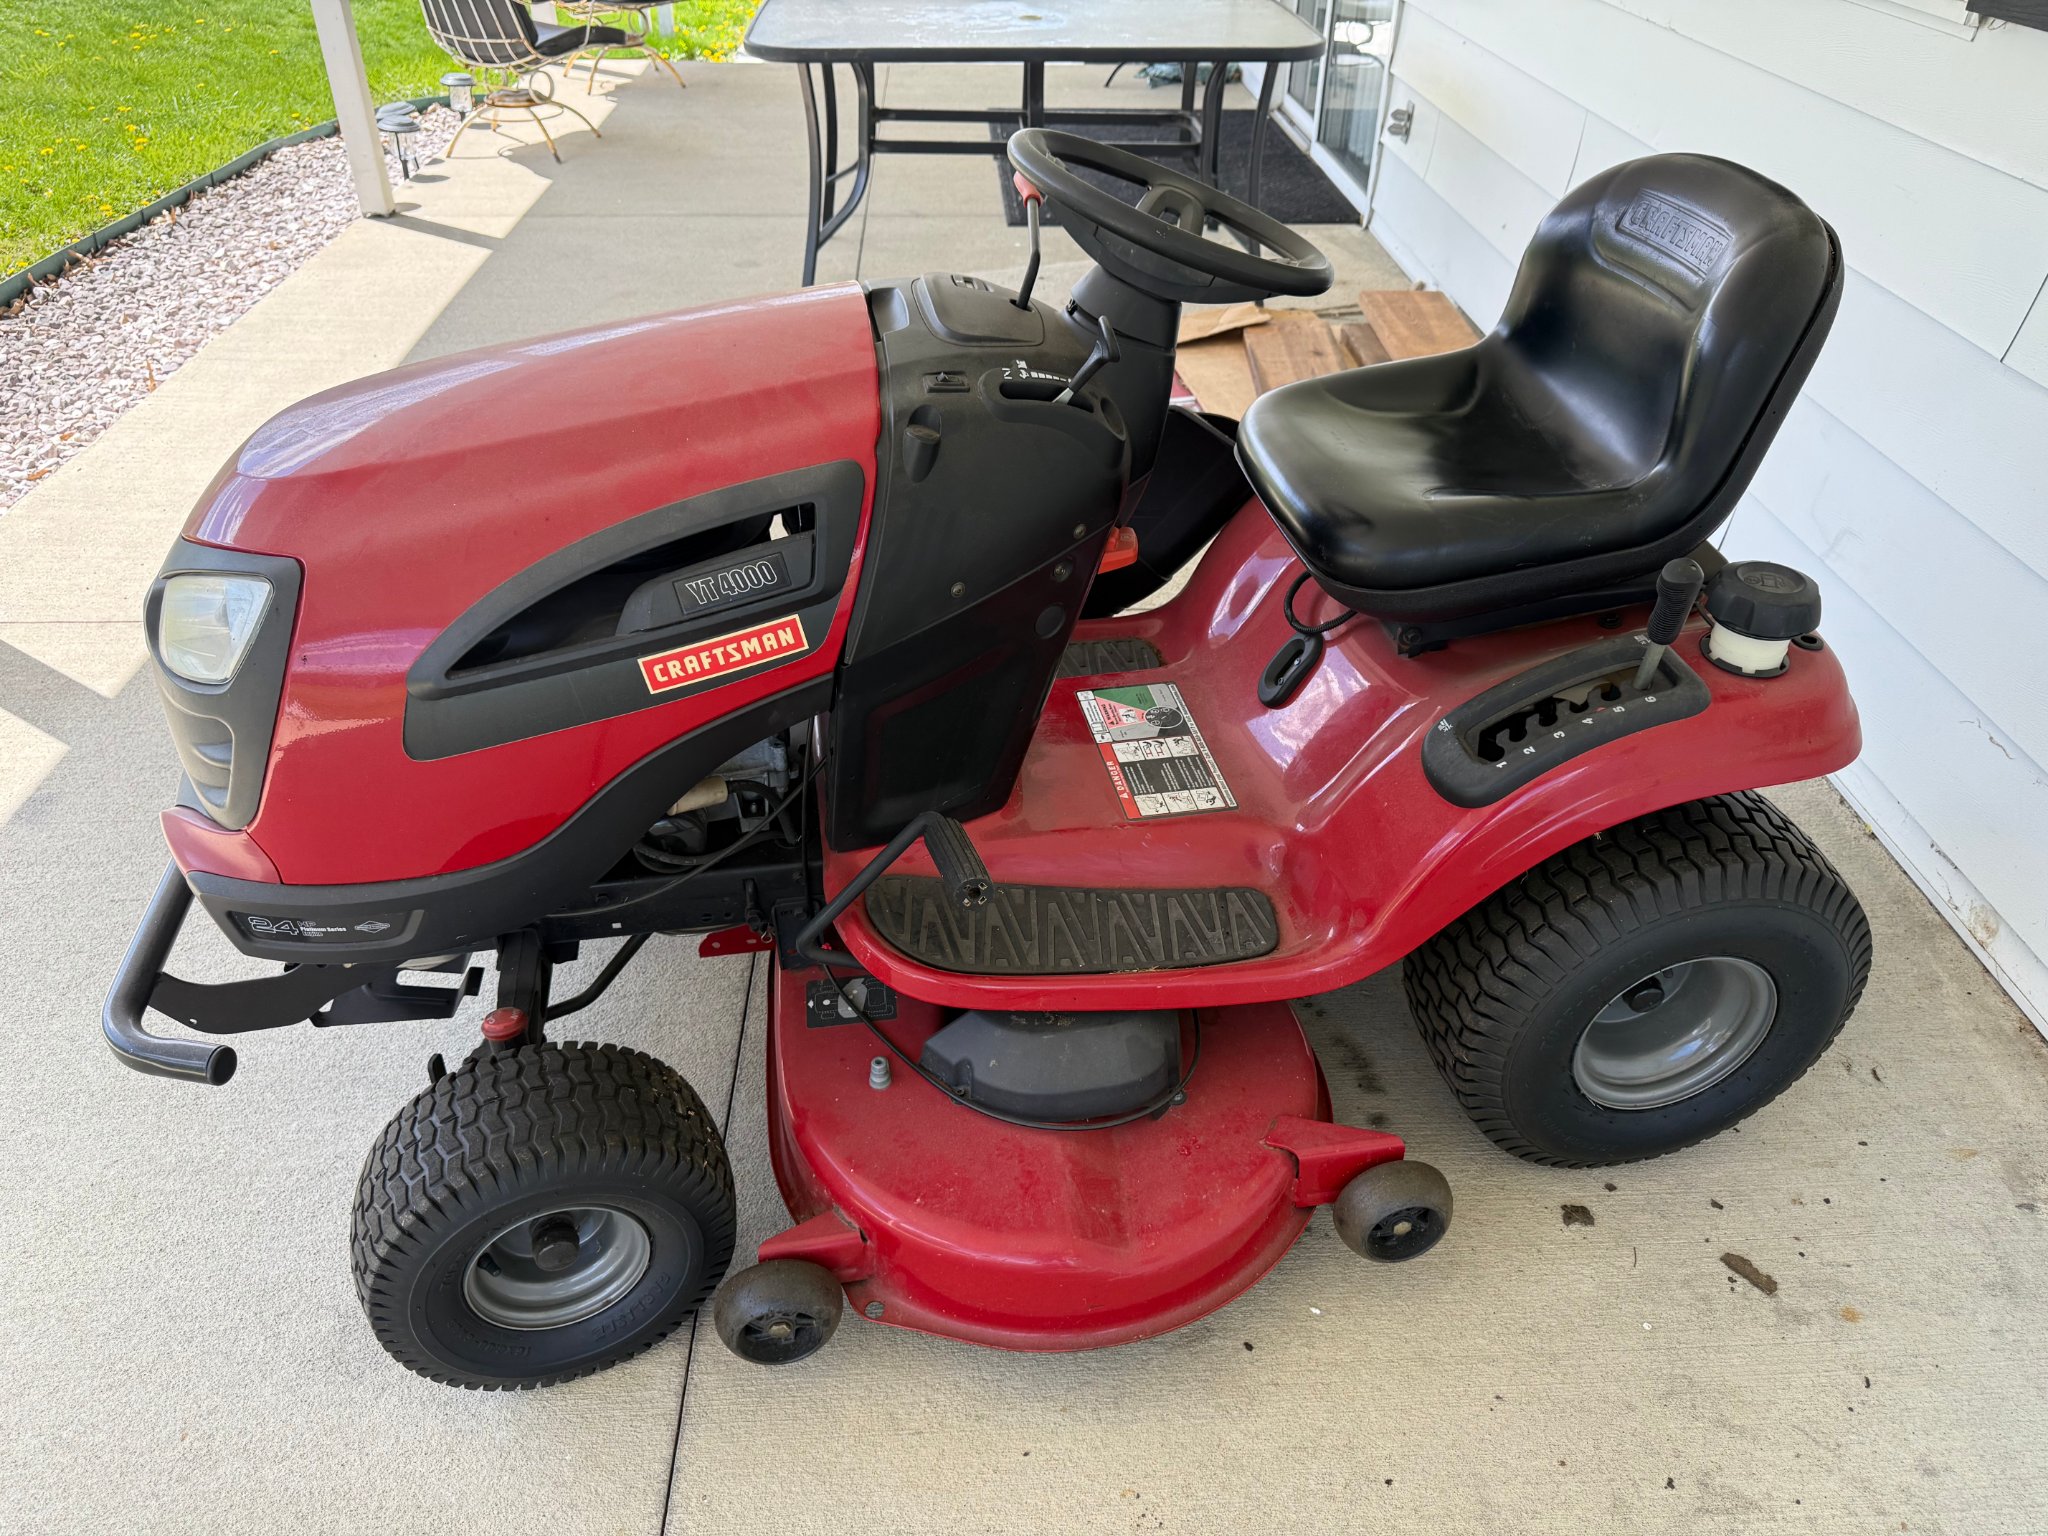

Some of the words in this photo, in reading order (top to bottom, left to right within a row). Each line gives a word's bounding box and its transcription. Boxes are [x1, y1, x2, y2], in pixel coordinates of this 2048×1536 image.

[1630, 200, 1724, 267] CRAFTSMAN
[685, 577, 720, 605] YT
[719, 561, 778, 595] 4000
[653, 627, 796, 682] CRAFTSMAN
[1523, 746, 1536, 754] 2
[1553, 730, 1566, 739] 3
[1582, 717, 1594, 725] 4
[1612, 705, 1626, 713] 5
[1106, 761, 1125, 791] DANGER
[248, 916, 299, 936] 24
